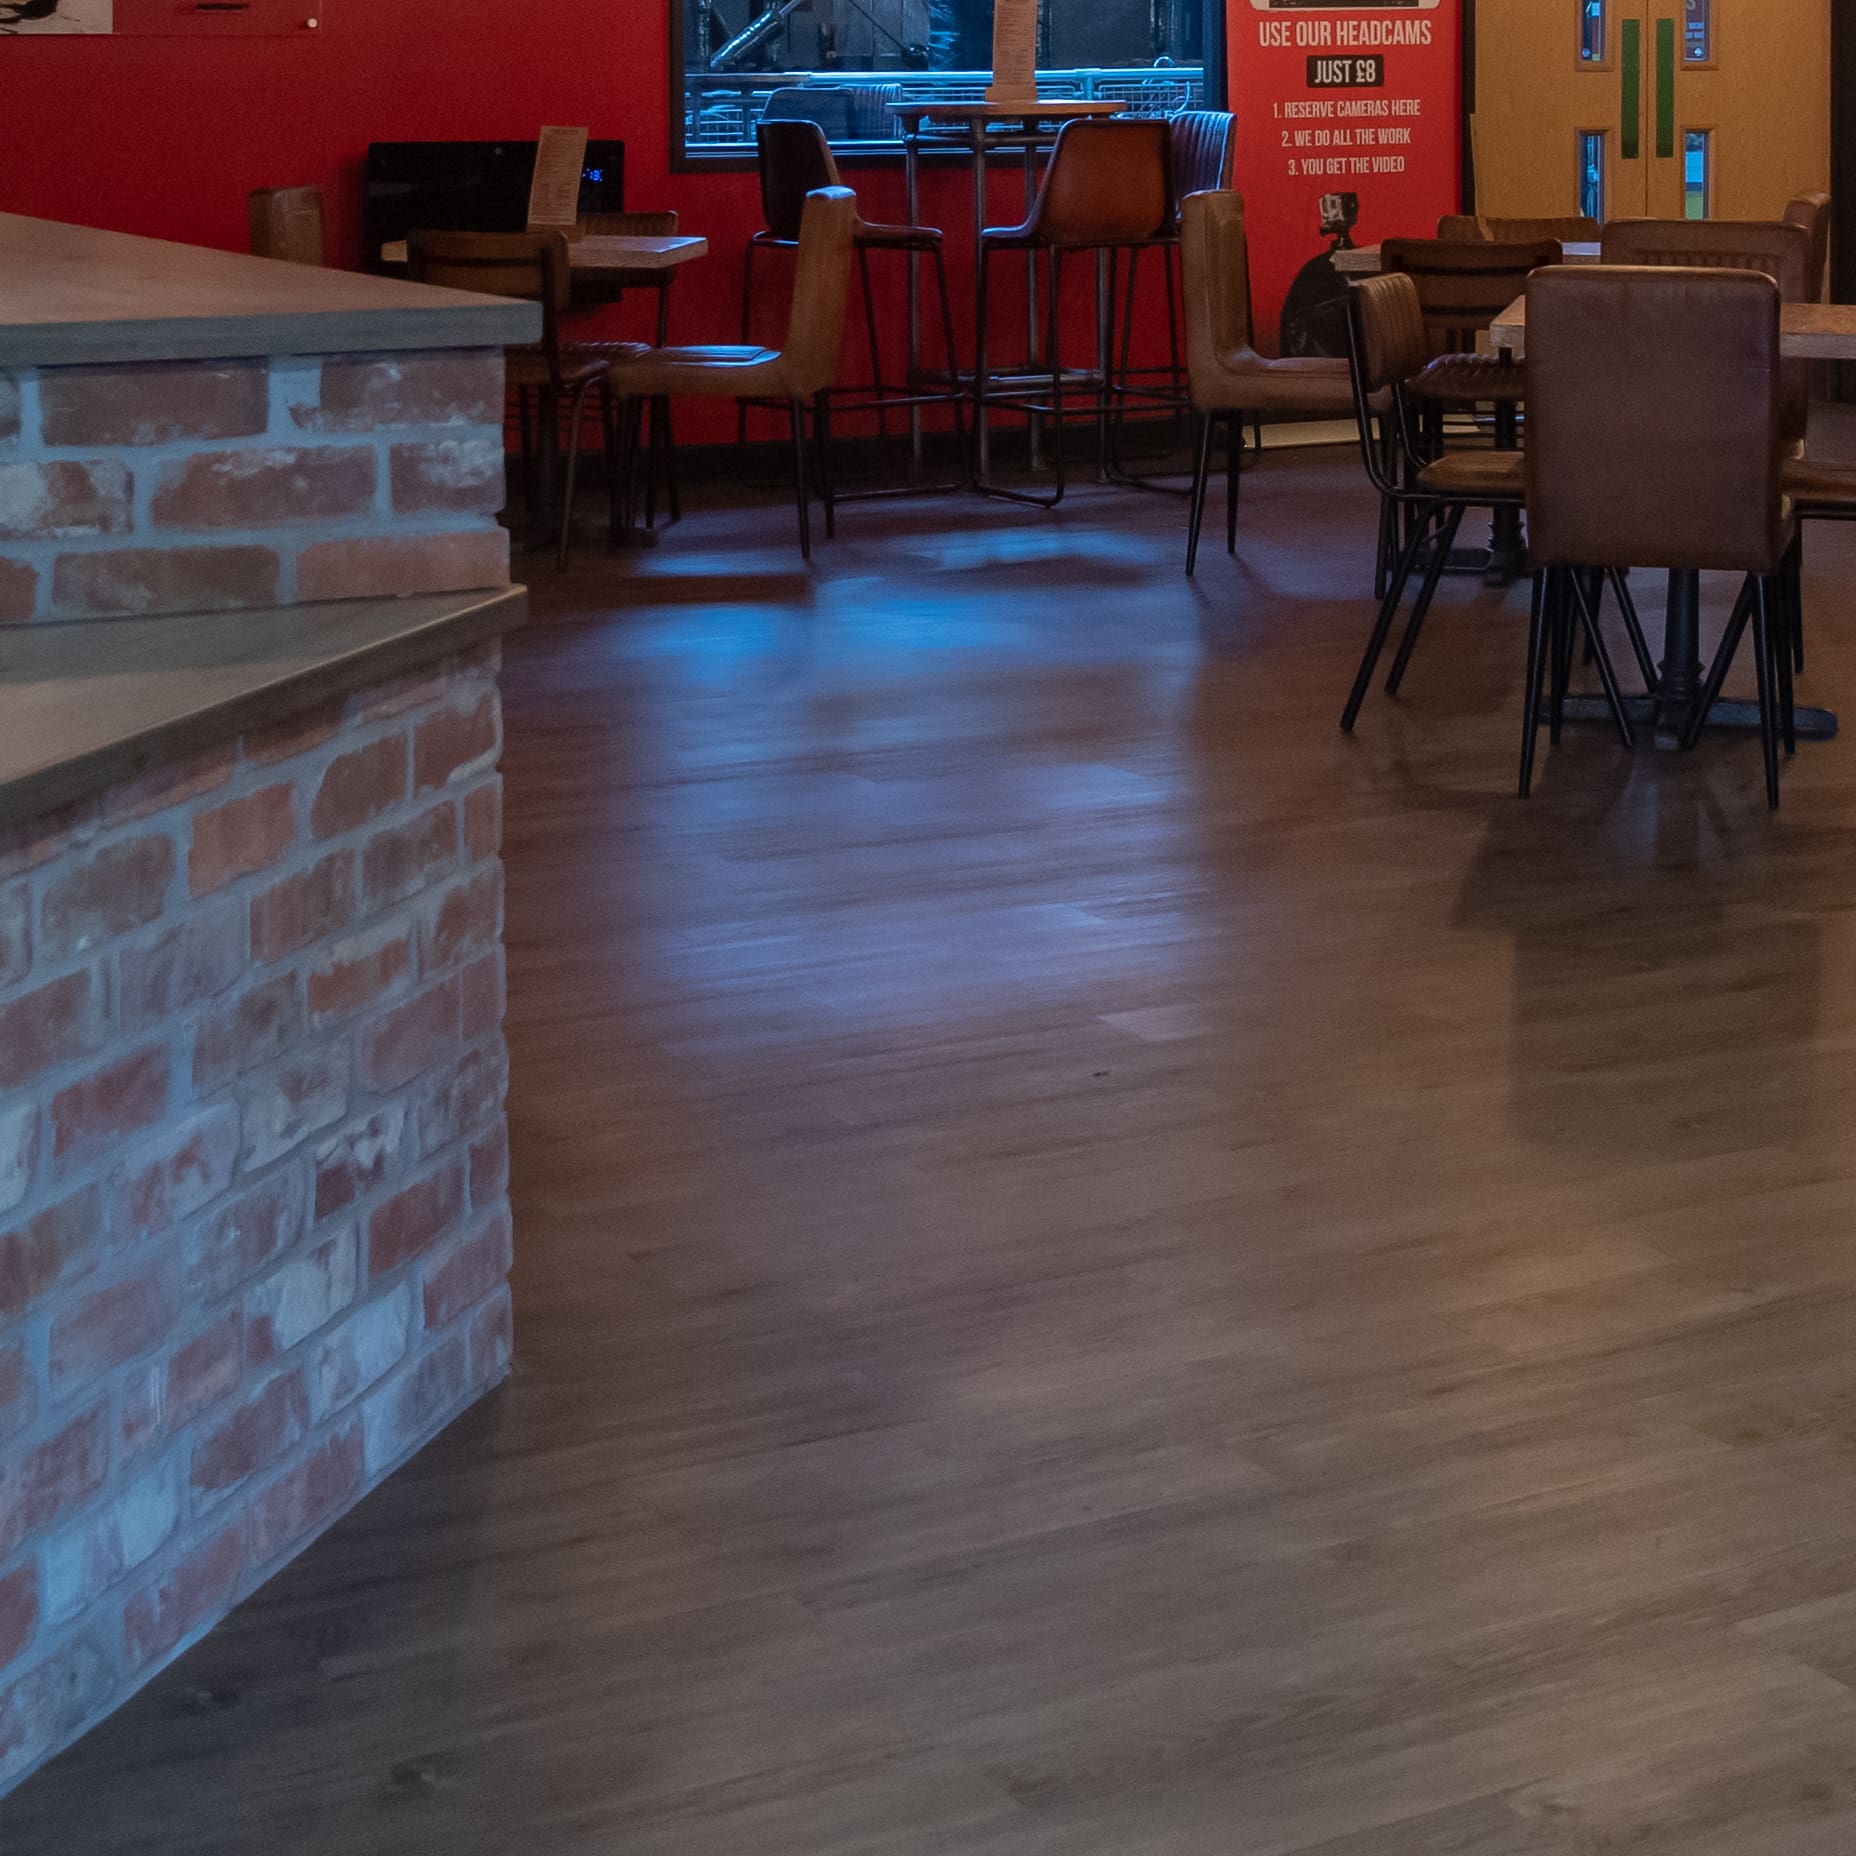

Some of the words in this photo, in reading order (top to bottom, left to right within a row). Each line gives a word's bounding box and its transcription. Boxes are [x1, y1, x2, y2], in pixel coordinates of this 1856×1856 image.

[1259, 21, 1292, 47] USE
[1296, 20, 1332, 46] OUR
[1336, 20, 1432, 46] HEADCAMS
[1314, 59, 1352, 84] JUST
[1355, 59, 1376, 83] £8
[1273, 103, 1282, 119] 1.
[1284, 100, 1335, 118] RESERVE
[1337, 99, 1389, 117] CAMERAS
[1391, 99, 1421, 116] HERE
[1282, 131, 1292, 147] 2.
[1295, 130, 1312, 147] WE
[1315, 129, 1330, 146] DO
[1332, 129, 1353, 146] ALL
[1355, 128, 1375, 145] THE
[1378, 127, 1411, 144] WORK
[1288, 159, 1299, 176] 3.
[1301, 158, 1324, 175] YOU
[1326, 157, 1347, 175] GET
[1349, 157, 1370, 174] THE
[1372, 156, 1405, 173] VIDEO
